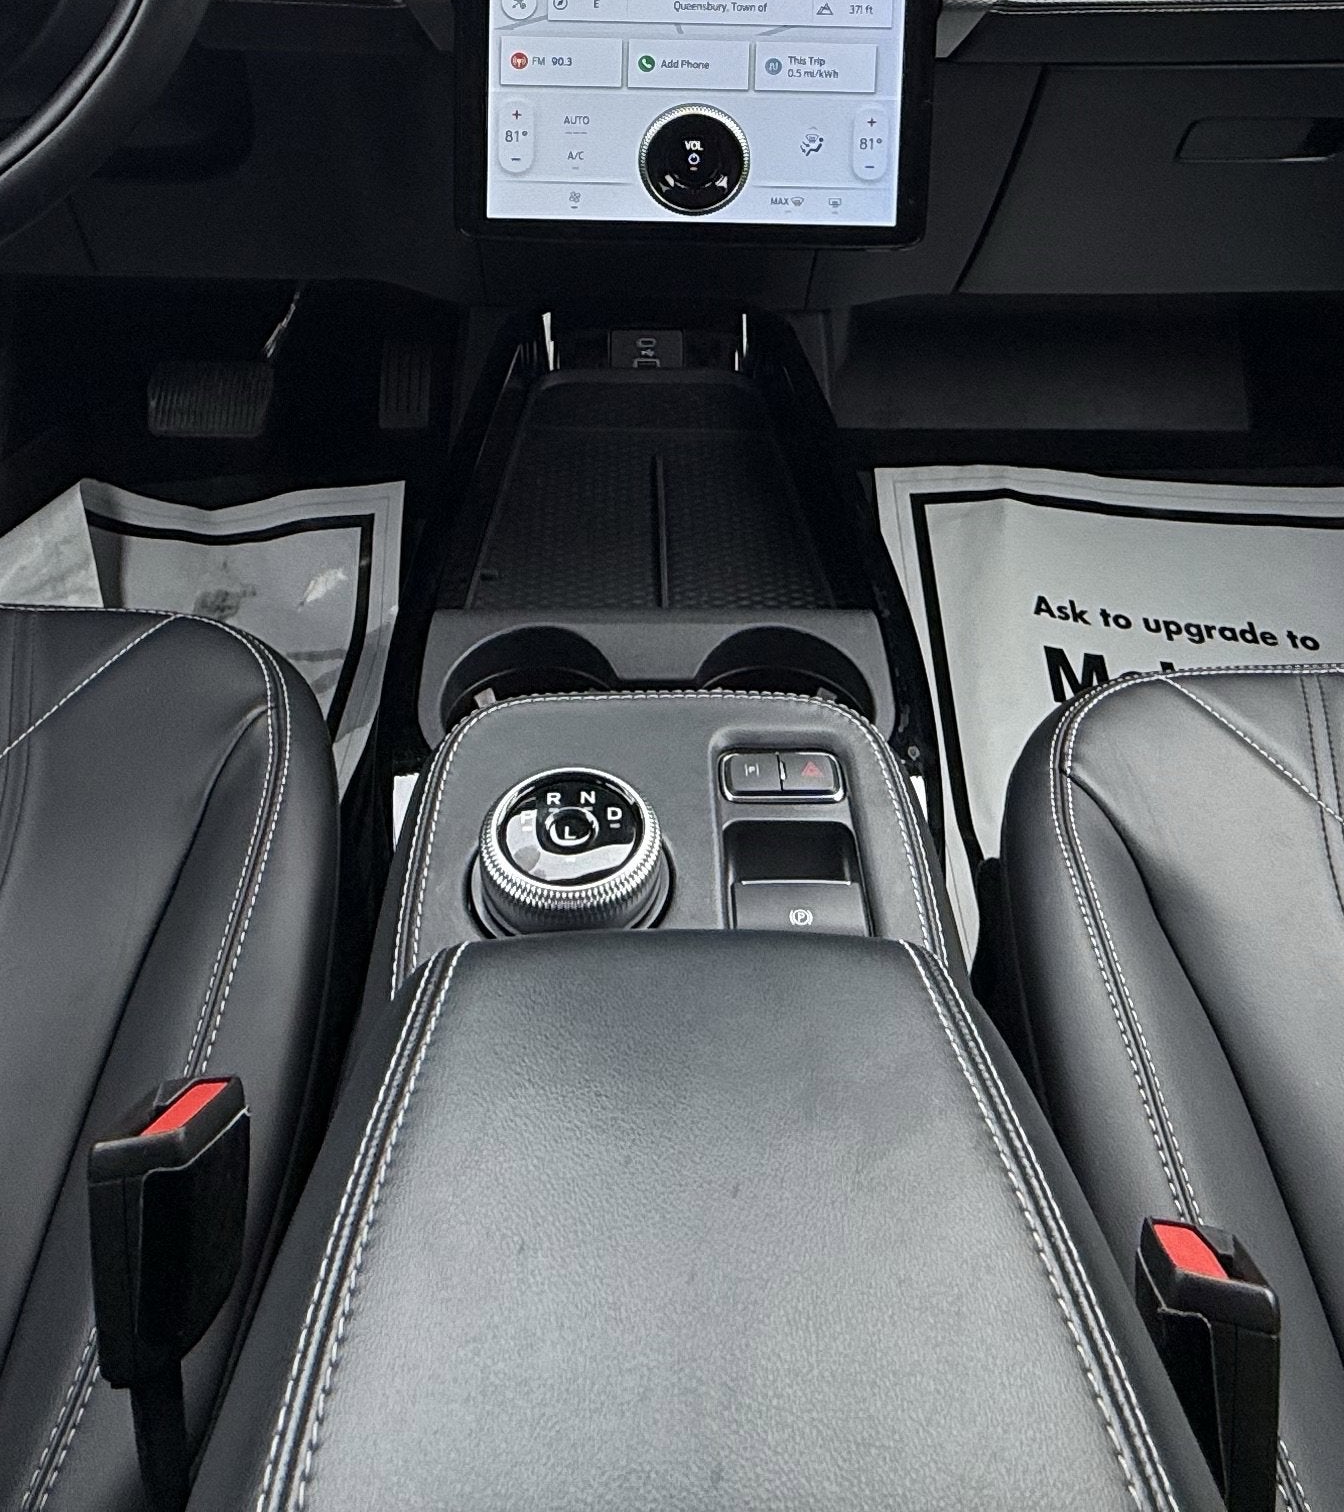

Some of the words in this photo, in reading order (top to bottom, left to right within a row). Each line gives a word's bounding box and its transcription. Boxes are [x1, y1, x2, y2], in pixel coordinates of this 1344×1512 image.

[593, 0, 600, 8] E
[674, 0, 729, 13] Queensbury,
[731, 2, 755, 12] Town
[757, 2, 768, 12] of
[865, 5, 874, 15] ft
[532, 57, 546, 66] FM
[552, 57, 573, 66] 90.3
[661, 59, 679, 69] Add
[680, 60, 710, 70] Phone
[787, 56, 807, 66] This
[808, 57, 826, 68] Trip
[787, 69, 802, 78] 0.5
[803, 69, 839, 79] mi/kWh
[563, 116, 590, 125] AUTO
[685, 140, 704, 151] VOL
[567, 150, 584, 161] A/C
[771, 197, 789, 206] MAX
[1033, 595, 1092, 626] Ask
[1099, 607, 1133, 630] to
[1142, 616, 1279, 647] upgrade
[1286, 629, 1320, 652] to
[546, 792, 562, 805] R
[580, 790, 596, 804] N
[607, 807, 622, 821] D
[564, 826, 576, 840] L
